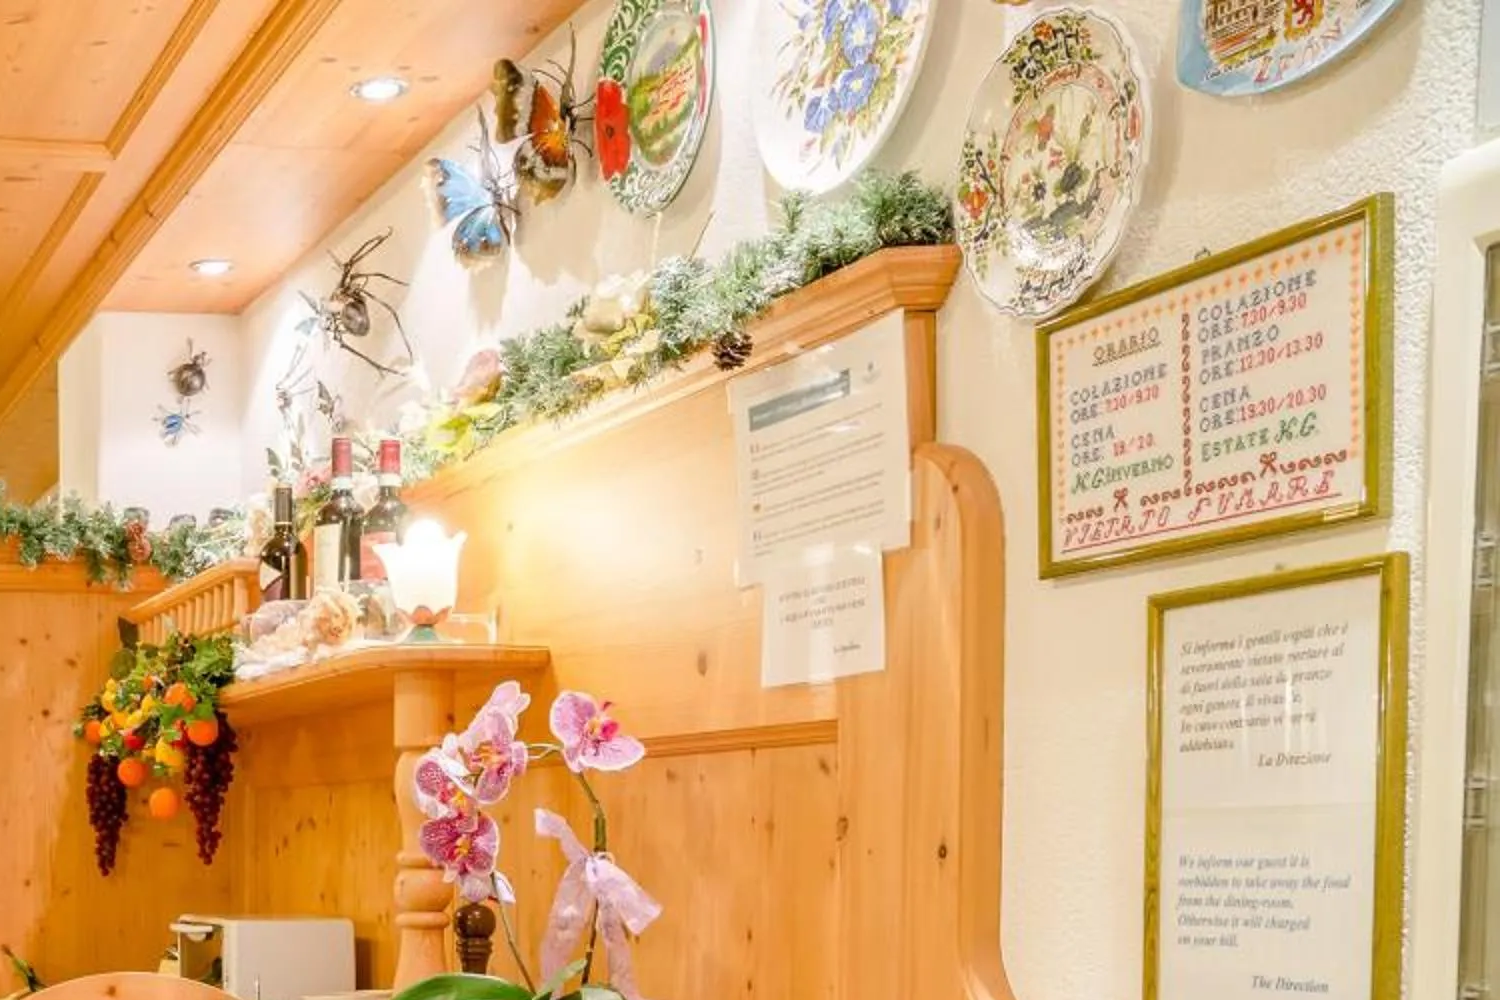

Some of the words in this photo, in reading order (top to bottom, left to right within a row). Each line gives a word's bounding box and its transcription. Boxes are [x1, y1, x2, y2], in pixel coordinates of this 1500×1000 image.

[1198, 269, 1317, 323] COLAZIONE
[1093, 326, 1160, 363] ORARIO
[1200, 324, 1280, 365] PRANZO
[1070, 363, 1168, 407] COLAZIONE
[1199, 386, 1251, 413] CENA
[1071, 424, 1116, 450] CENA
[1201, 427, 1269, 462] ESTATE
[1064, 505, 1172, 547] VIETATO
[1188, 470, 1335, 522] FUMARE
[1317, 623, 1339, 638] che
[1275, 751, 1332, 768] Direzione
[1301, 875, 1320, 889] the
[1177, 914, 1230, 928] Otherwise
[1252, 975, 1272, 990] The
[1275, 976, 1330, 994] Direction
